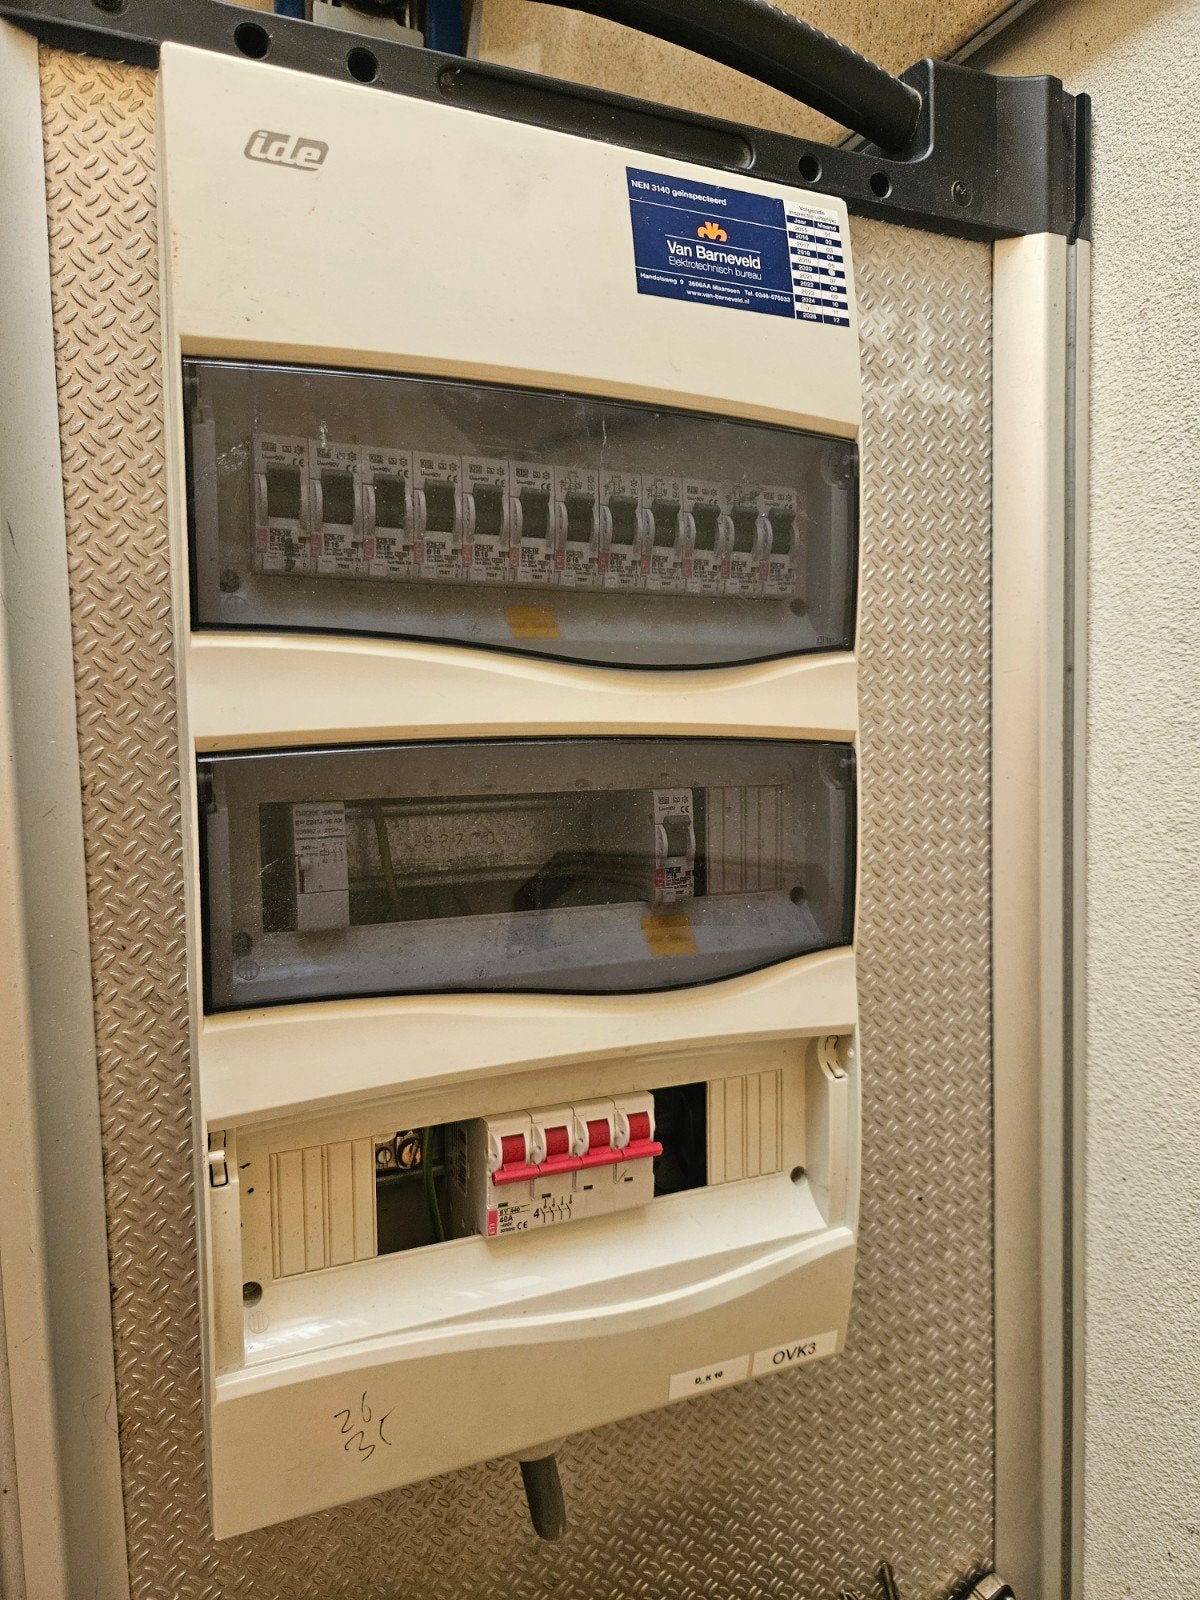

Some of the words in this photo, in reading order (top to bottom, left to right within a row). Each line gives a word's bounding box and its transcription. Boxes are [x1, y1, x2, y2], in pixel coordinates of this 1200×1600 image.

[244, 129, 329, 171] ide
[631, 179, 650, 190] NEN
[651, 184, 670, 195] 3140
[817, 223, 837, 231] Maand
[667, 240, 693, 258] Van
[696, 245, 761, 270] Barneveld
[669, 256, 733, 276] Elektrotechnisch
[735, 268, 762, 281] bureau
[640, 272, 678, 285] Handelsweg
[687, 289, 750, 305] www.van-barneveld.nl
[500, 1215, 513, 1223] 40A
[772, 1342, 816, 1365] OVK3
